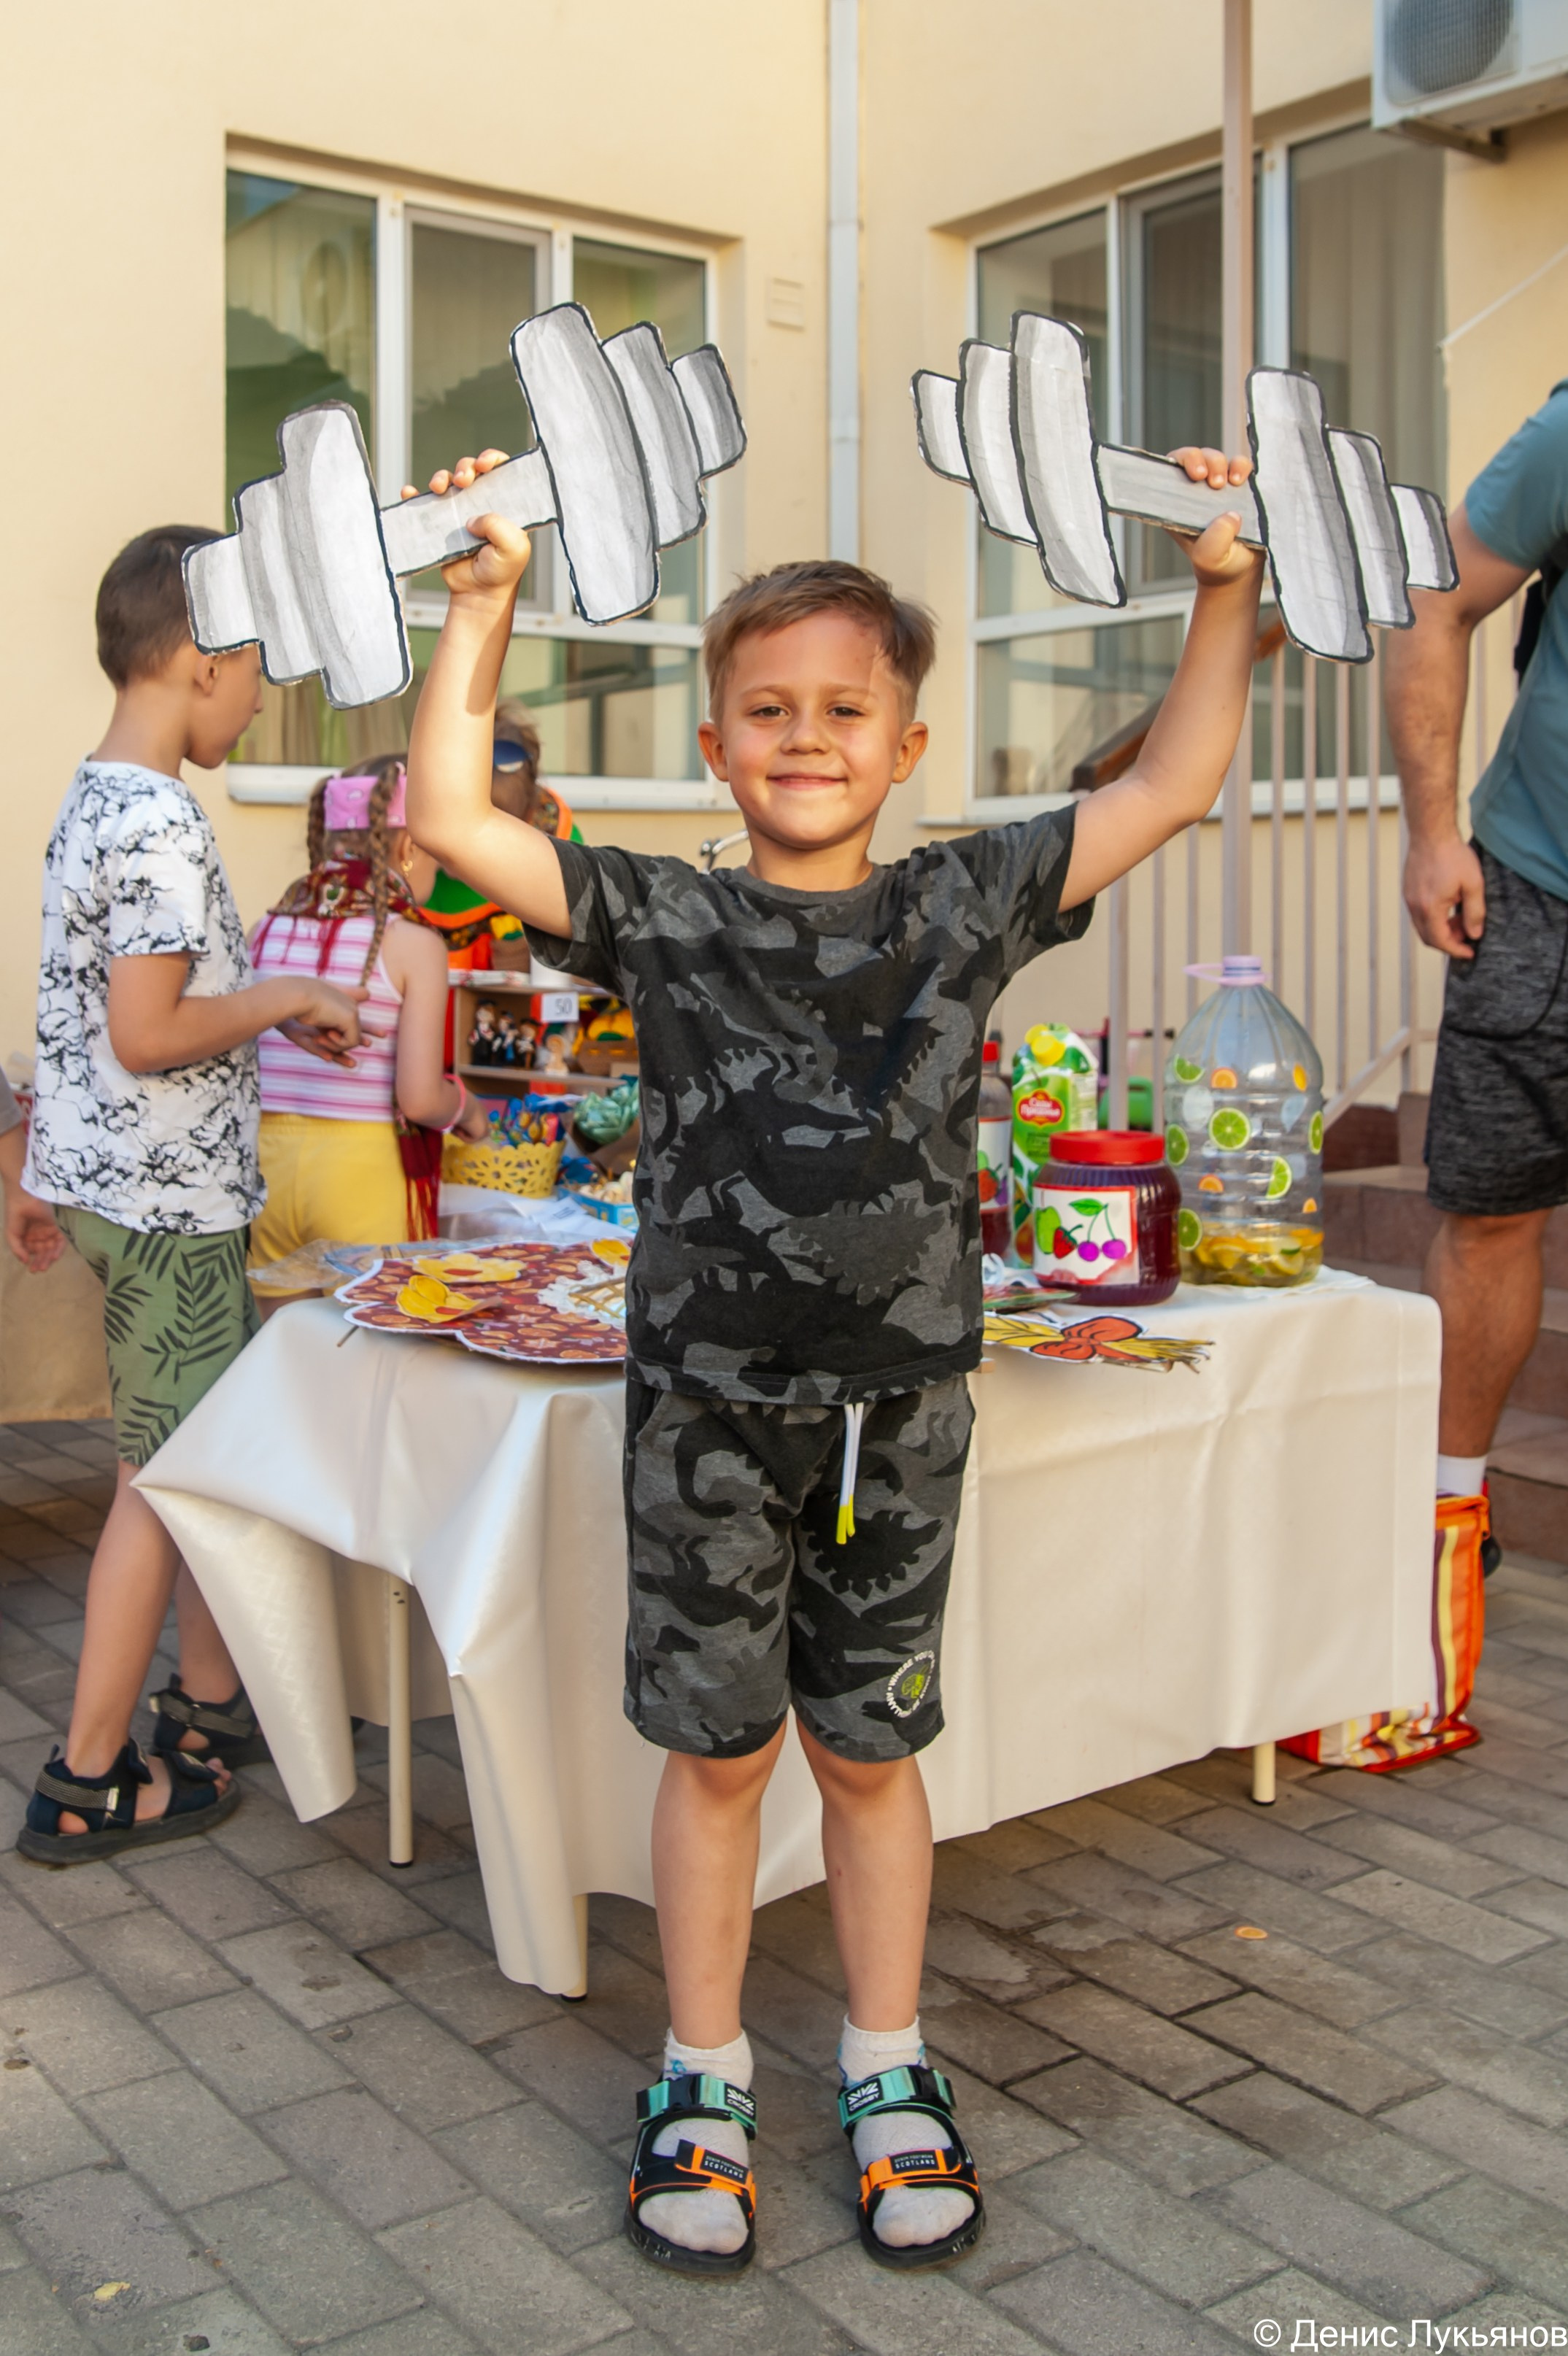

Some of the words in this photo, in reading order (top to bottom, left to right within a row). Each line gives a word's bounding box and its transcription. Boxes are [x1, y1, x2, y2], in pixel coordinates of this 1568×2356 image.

[555, 997, 573, 1016] 50
[728, 2098, 754, 2117] CROSBY
[849, 2093, 880, 2111] CROSBY
[704, 2160, 744, 2179] SCOTLAND
[895, 2159, 935, 2169] SCOTLAND
